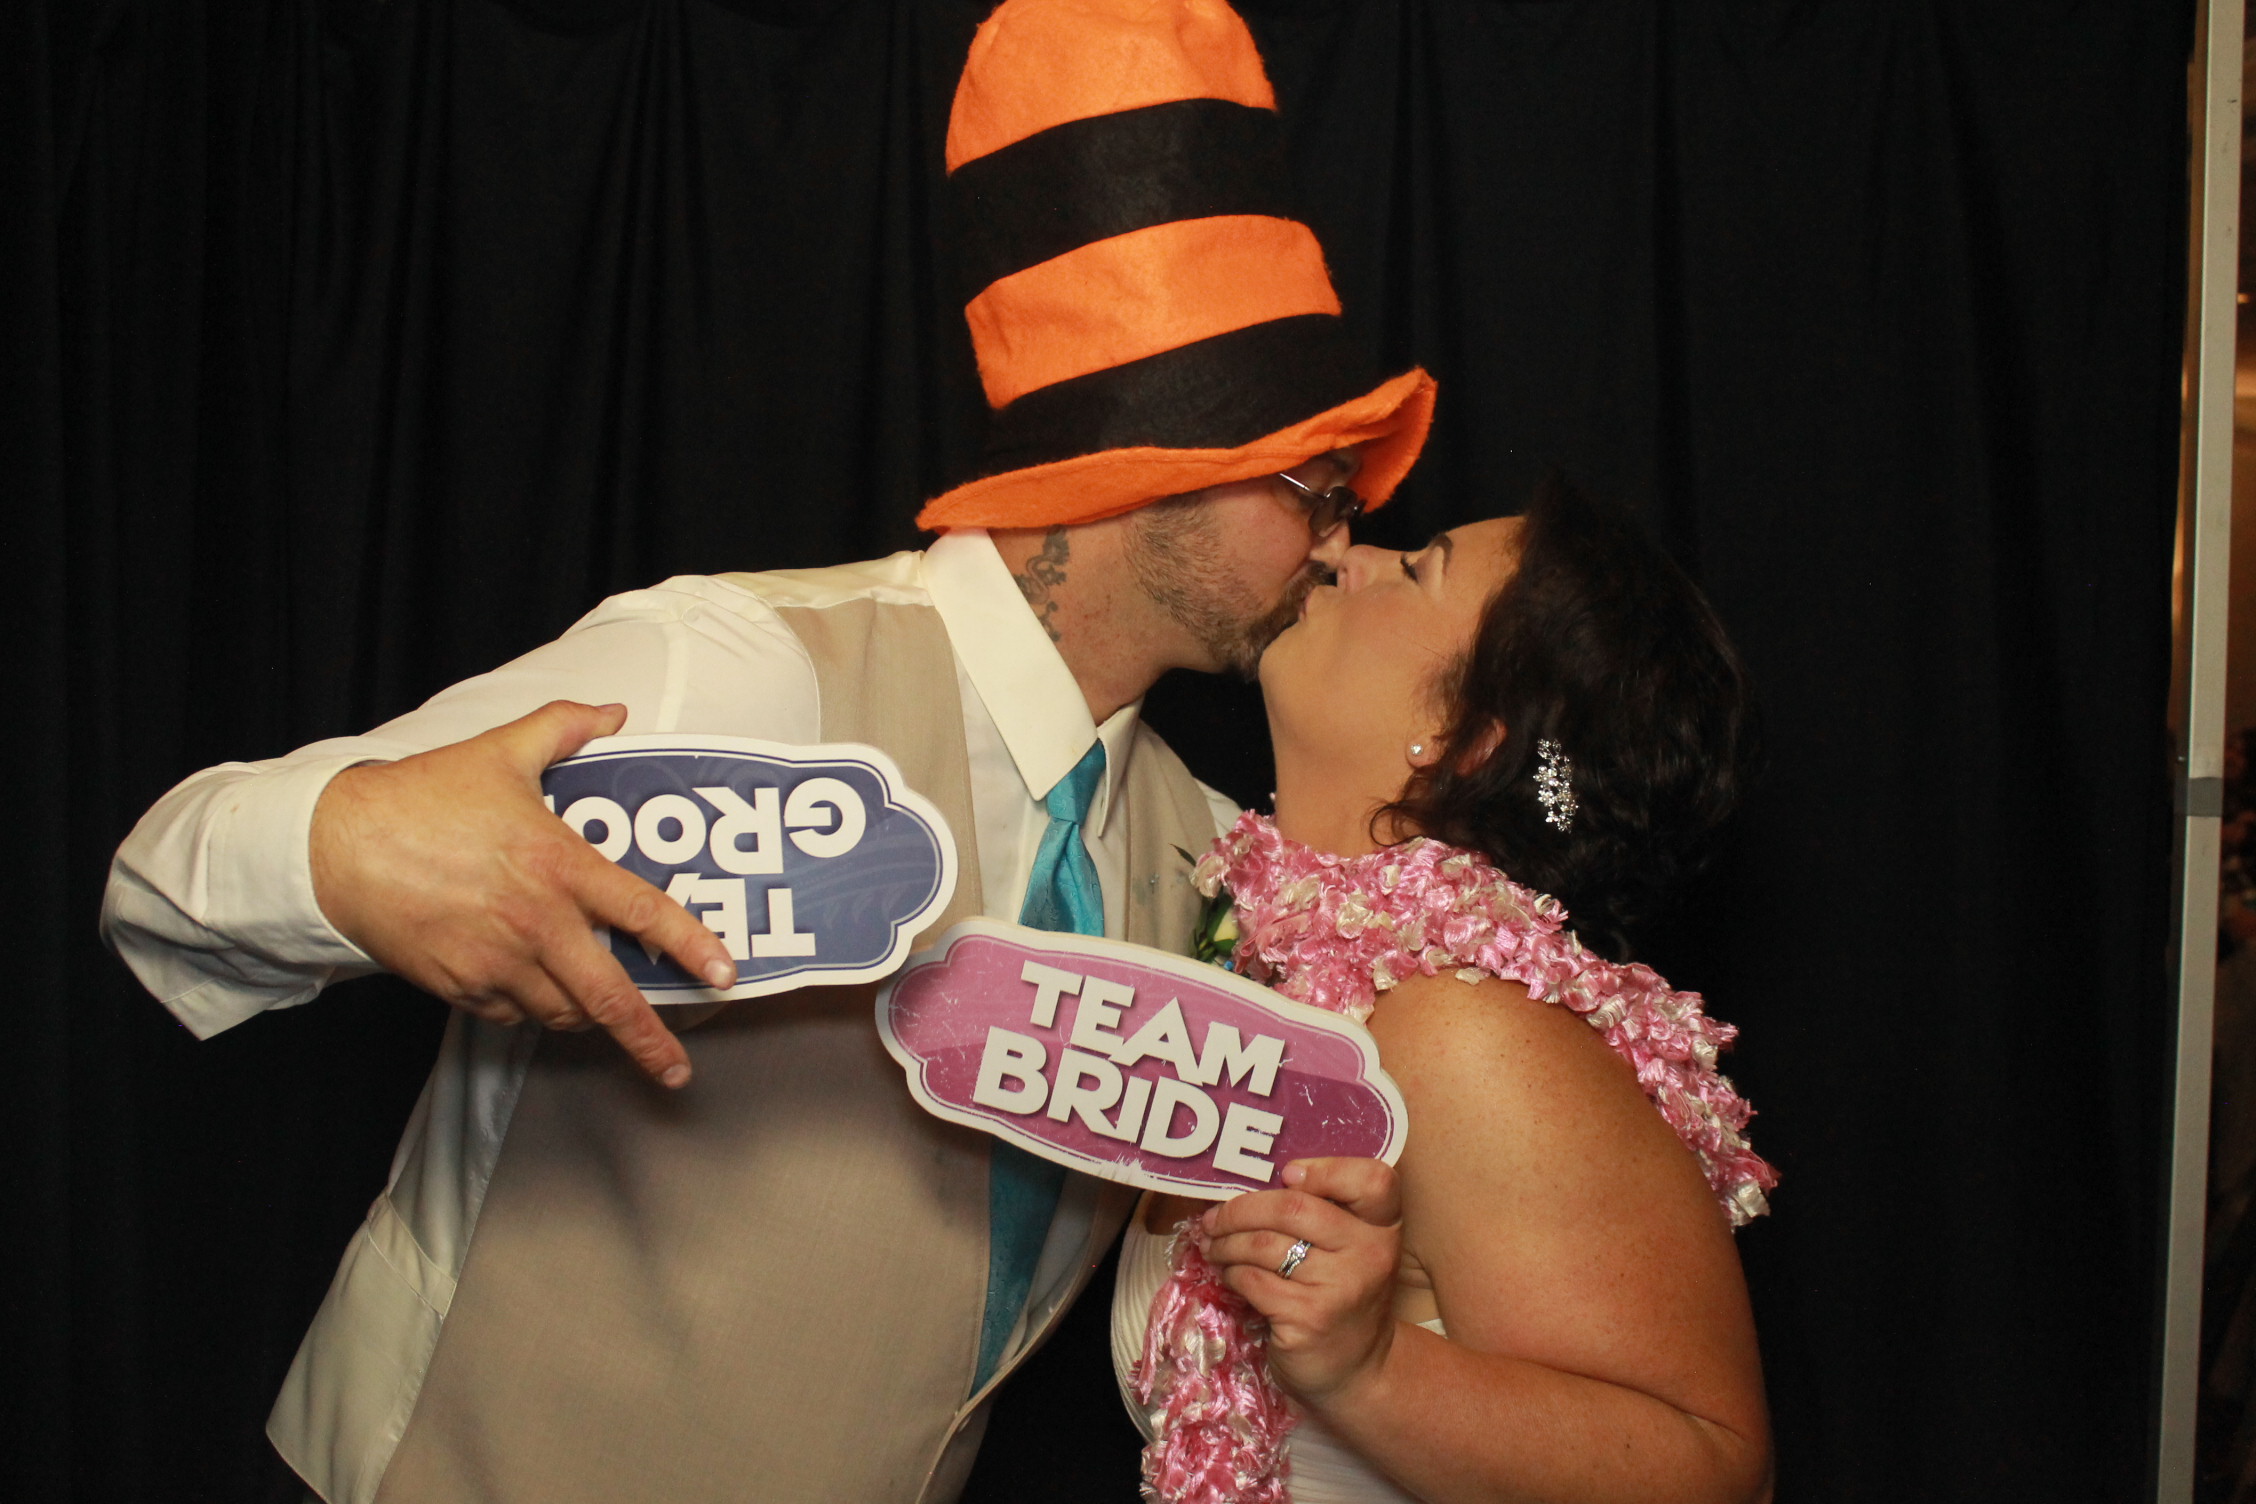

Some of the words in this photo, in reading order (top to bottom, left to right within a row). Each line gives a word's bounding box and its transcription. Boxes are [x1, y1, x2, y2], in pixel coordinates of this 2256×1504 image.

[544, 777, 866, 875] GROO
[592, 873, 816, 965] TE
[1021, 960, 1285, 1097] TEAM
[972, 1026, 1284, 1183] BRIDE
